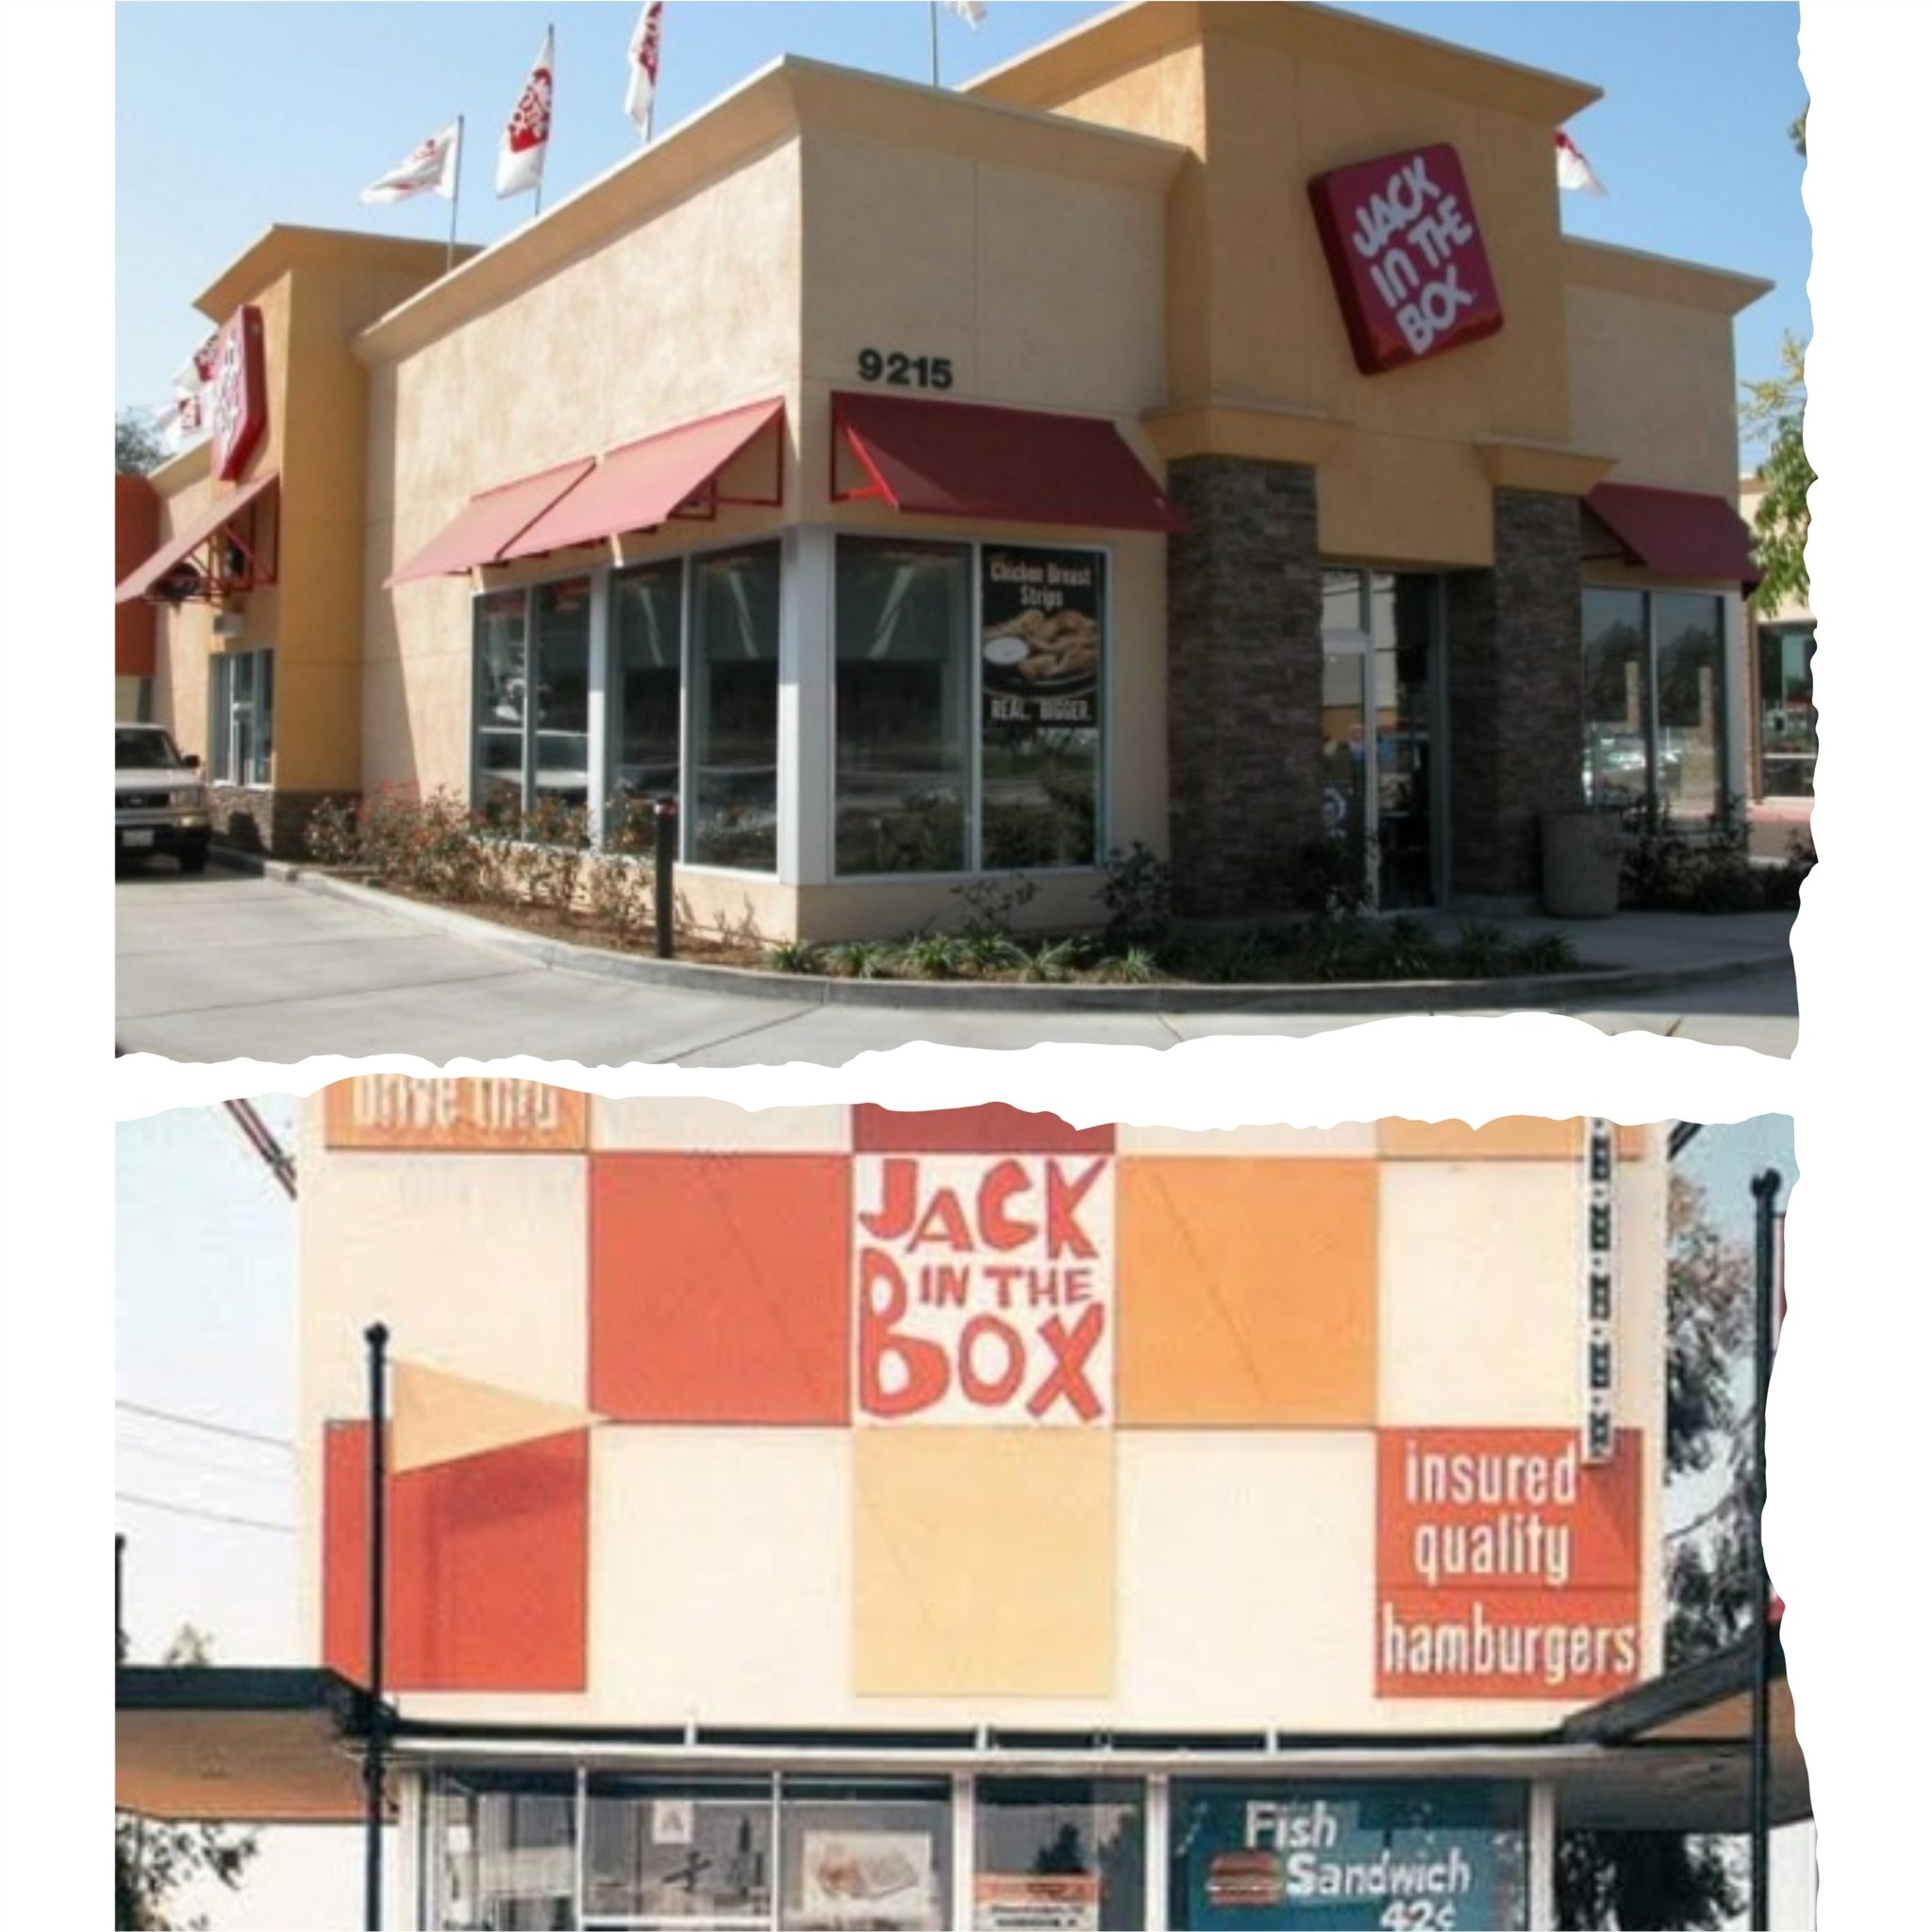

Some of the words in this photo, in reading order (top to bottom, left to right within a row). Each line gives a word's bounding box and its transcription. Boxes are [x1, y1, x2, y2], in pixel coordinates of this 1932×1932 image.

[1353, 156, 1441, 258] JACK
[1370, 247, 1420, 308] IN
[1407, 194, 1474, 269] THE
[1394, 264, 1474, 356] BOX
[858, 348, 953, 390] 9215
[991, 558, 1044, 582] Chicken
[1021, 584, 1063, 610] Strips
[858, 1158, 1107, 1259] JACK
[919, 1265, 970, 1307] IN
[983, 1265, 1094, 1308] THE
[858, 1246, 1104, 1424] BOX
[1406, 1439, 1577, 1506] insured
[1414, 1513, 1570, 1588] quality
[1381, 1601, 1636, 1686] hamburgers
[1244, 1800, 1339, 1850] Fish
[1286, 1845, 1472, 1898] Sandwich
